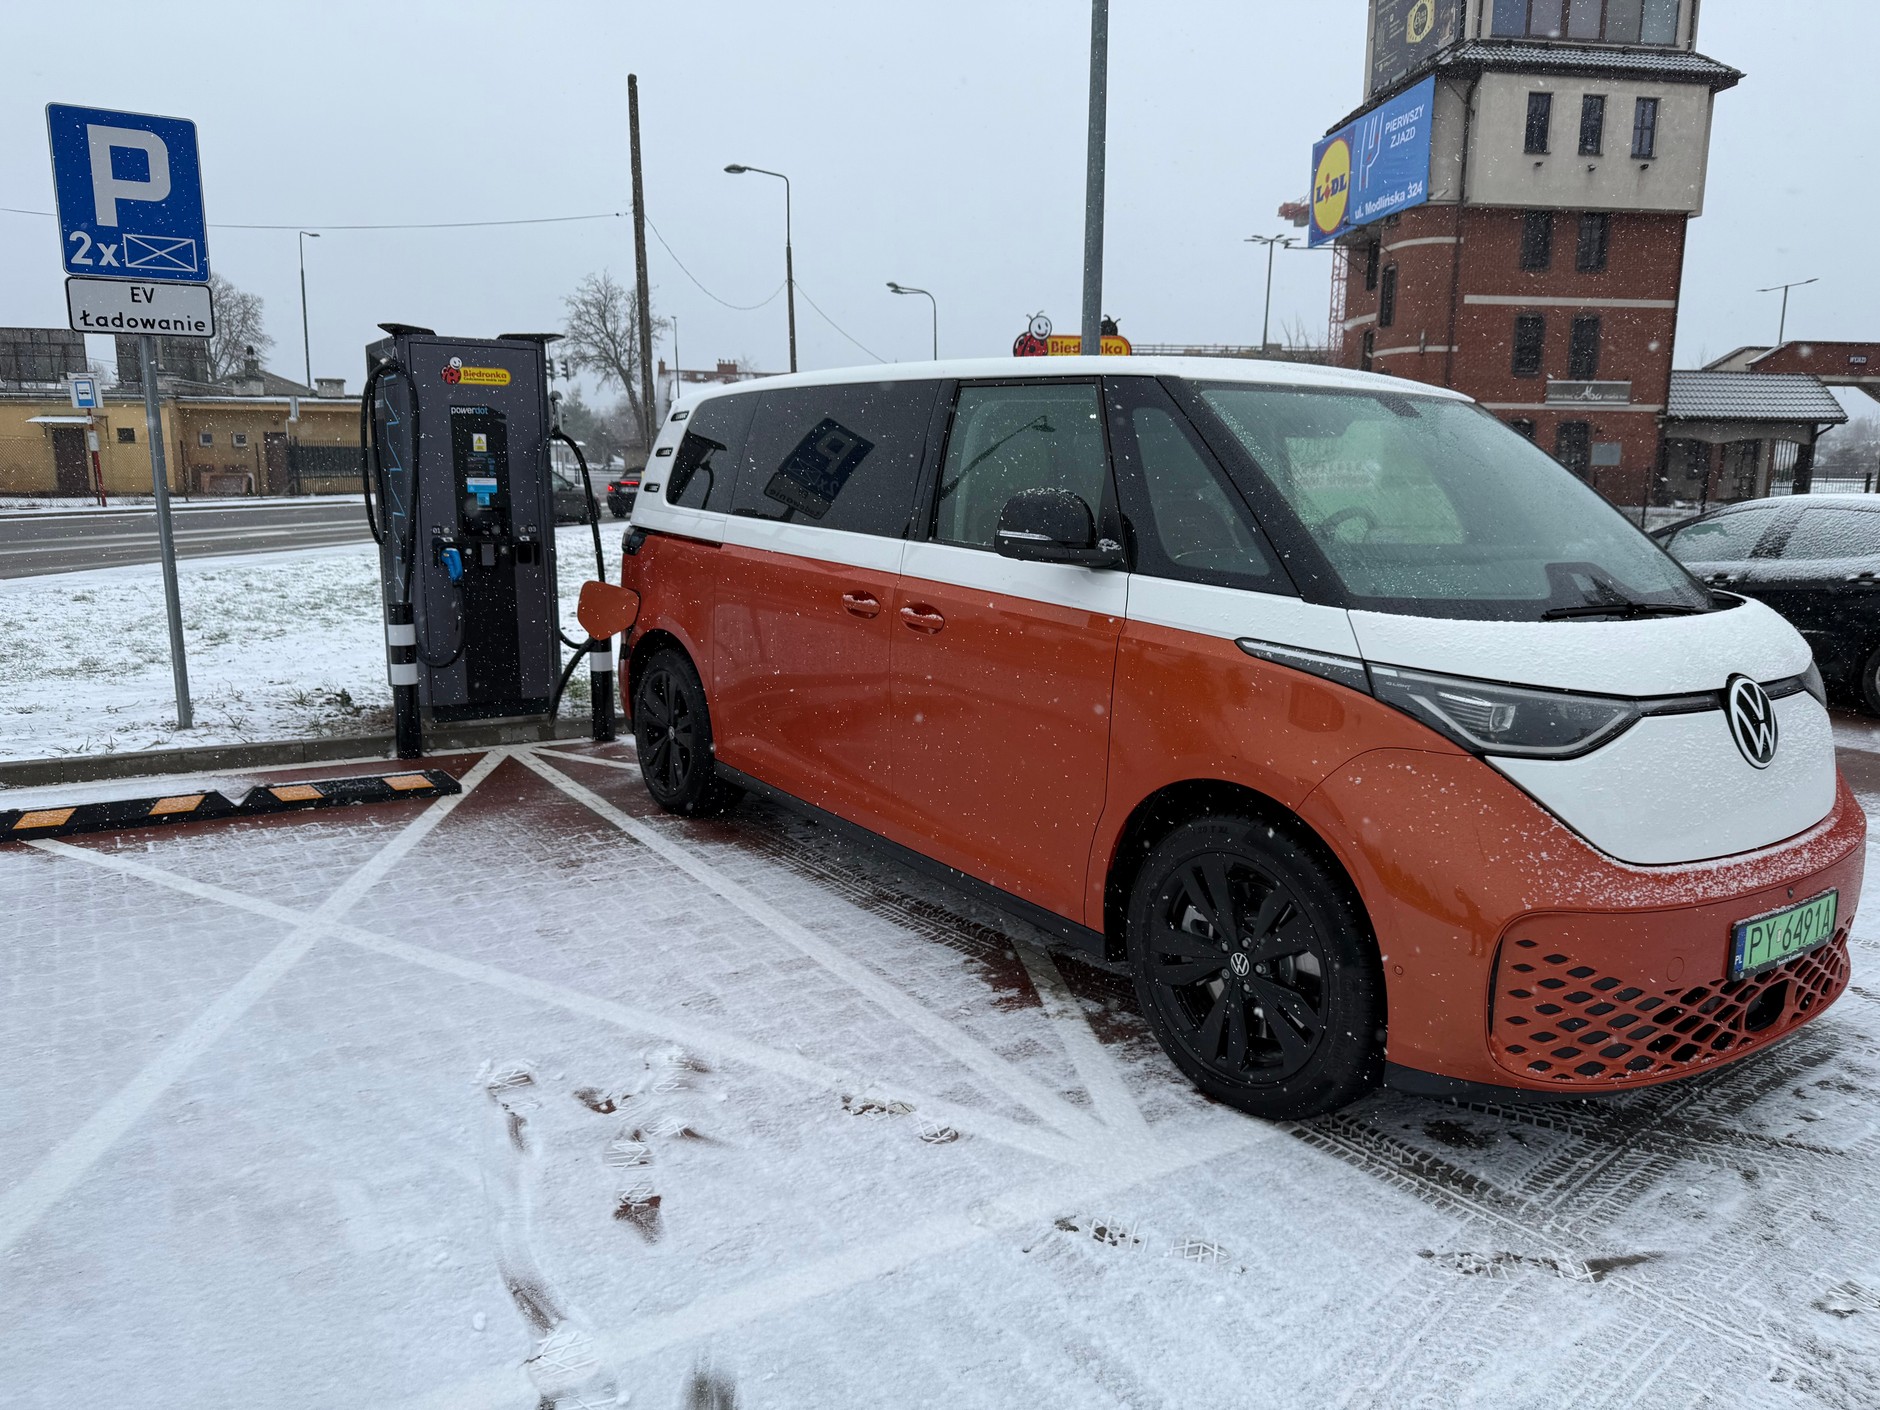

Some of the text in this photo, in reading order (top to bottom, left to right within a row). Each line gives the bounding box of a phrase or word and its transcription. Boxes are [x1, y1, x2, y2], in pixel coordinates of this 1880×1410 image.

[1385, 104, 1425, 135] PIERWSZY
[1390, 126, 1416, 149] ZJAZD
[86, 123, 171, 227] P
[1354, 181, 1423, 219] ul. Modlińska 324
[130, 286, 155, 304] EV
[80, 310, 206, 332] Ładowanie
[1051, 340, 1123, 355] Biedka
[463, 369, 507, 379] Biedronka
[450, 406, 489, 415] powerdot
[1730, 677, 1778, 769] VW
[1749, 899, 1831, 965] PY 6491A
[1230, 952, 1250, 977] VW
[1734, 954, 1743, 965] PL
